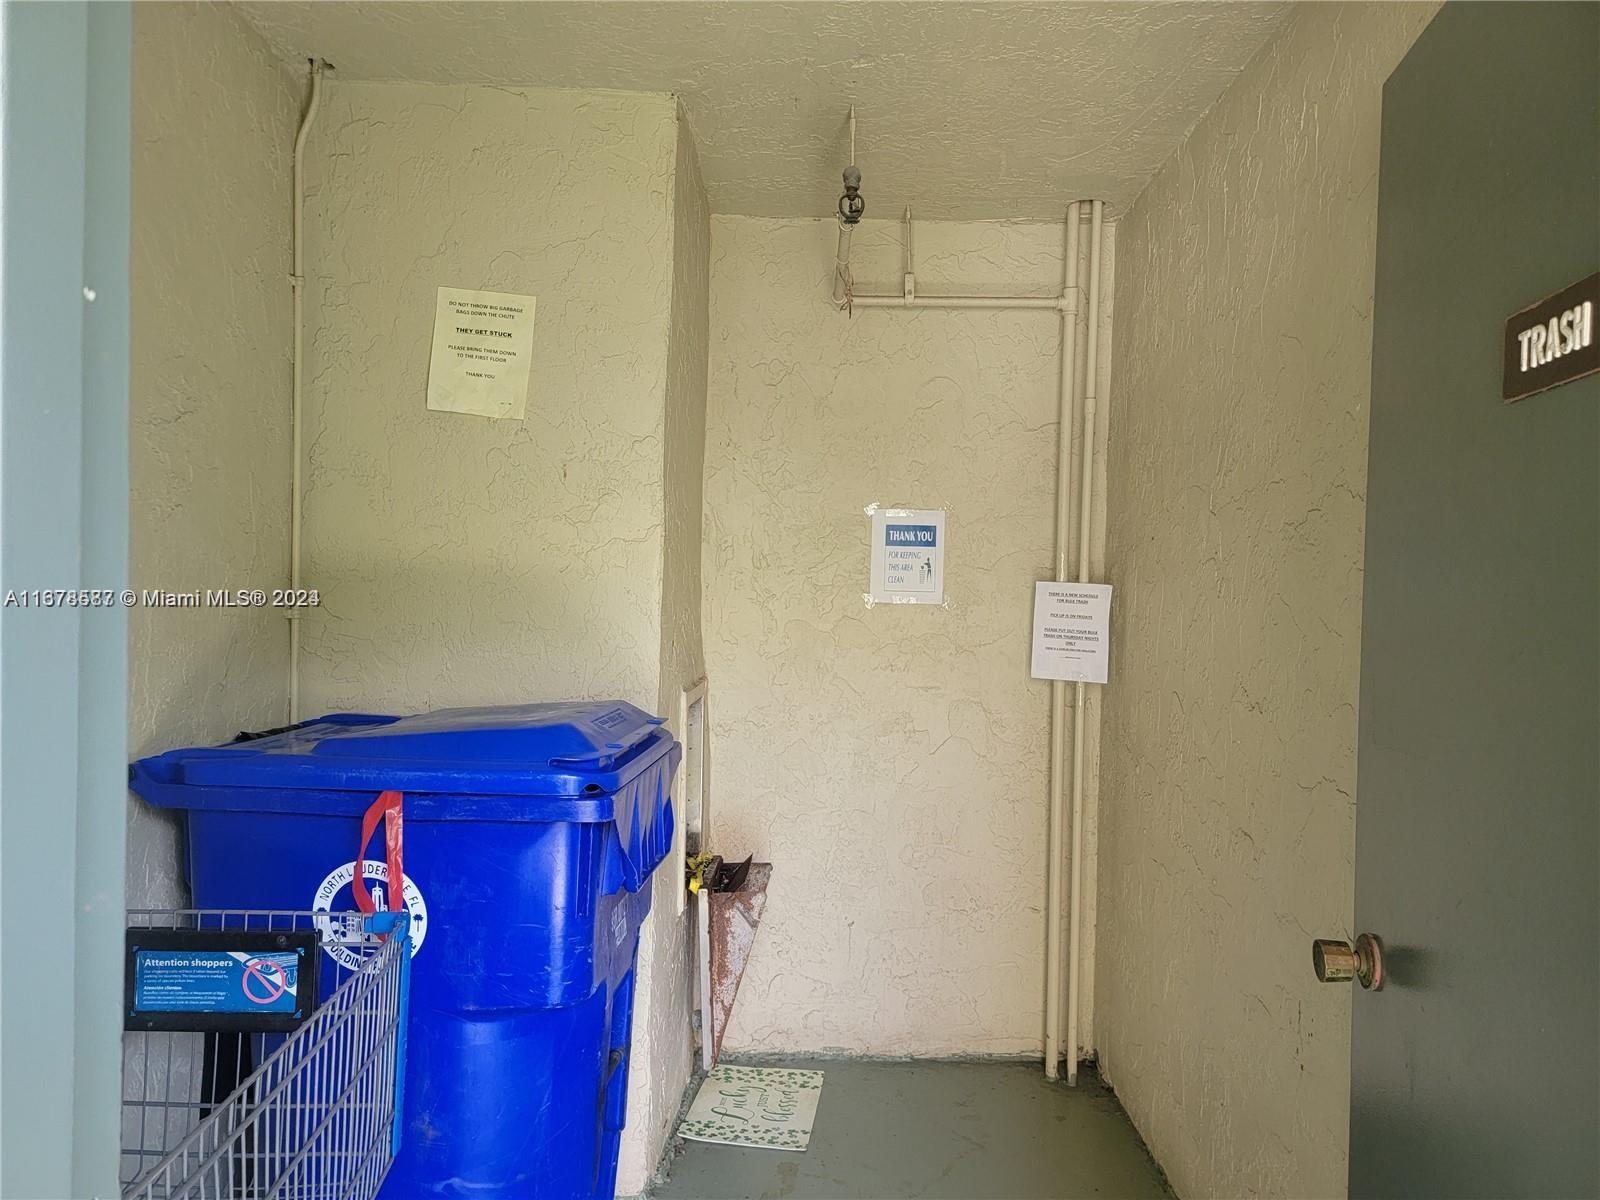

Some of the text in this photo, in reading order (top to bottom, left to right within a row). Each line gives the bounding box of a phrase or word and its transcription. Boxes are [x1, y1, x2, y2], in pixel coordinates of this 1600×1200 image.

[1518, 301, 1592, 372] TRASH
[889, 530, 933, 542] THANK YOU
[888, 576, 904, 584] CLEAN
[320, 871, 346, 902] NORTH
[409, 896, 420, 908] FL
[144, 959, 233, 968] Attention shoppers
